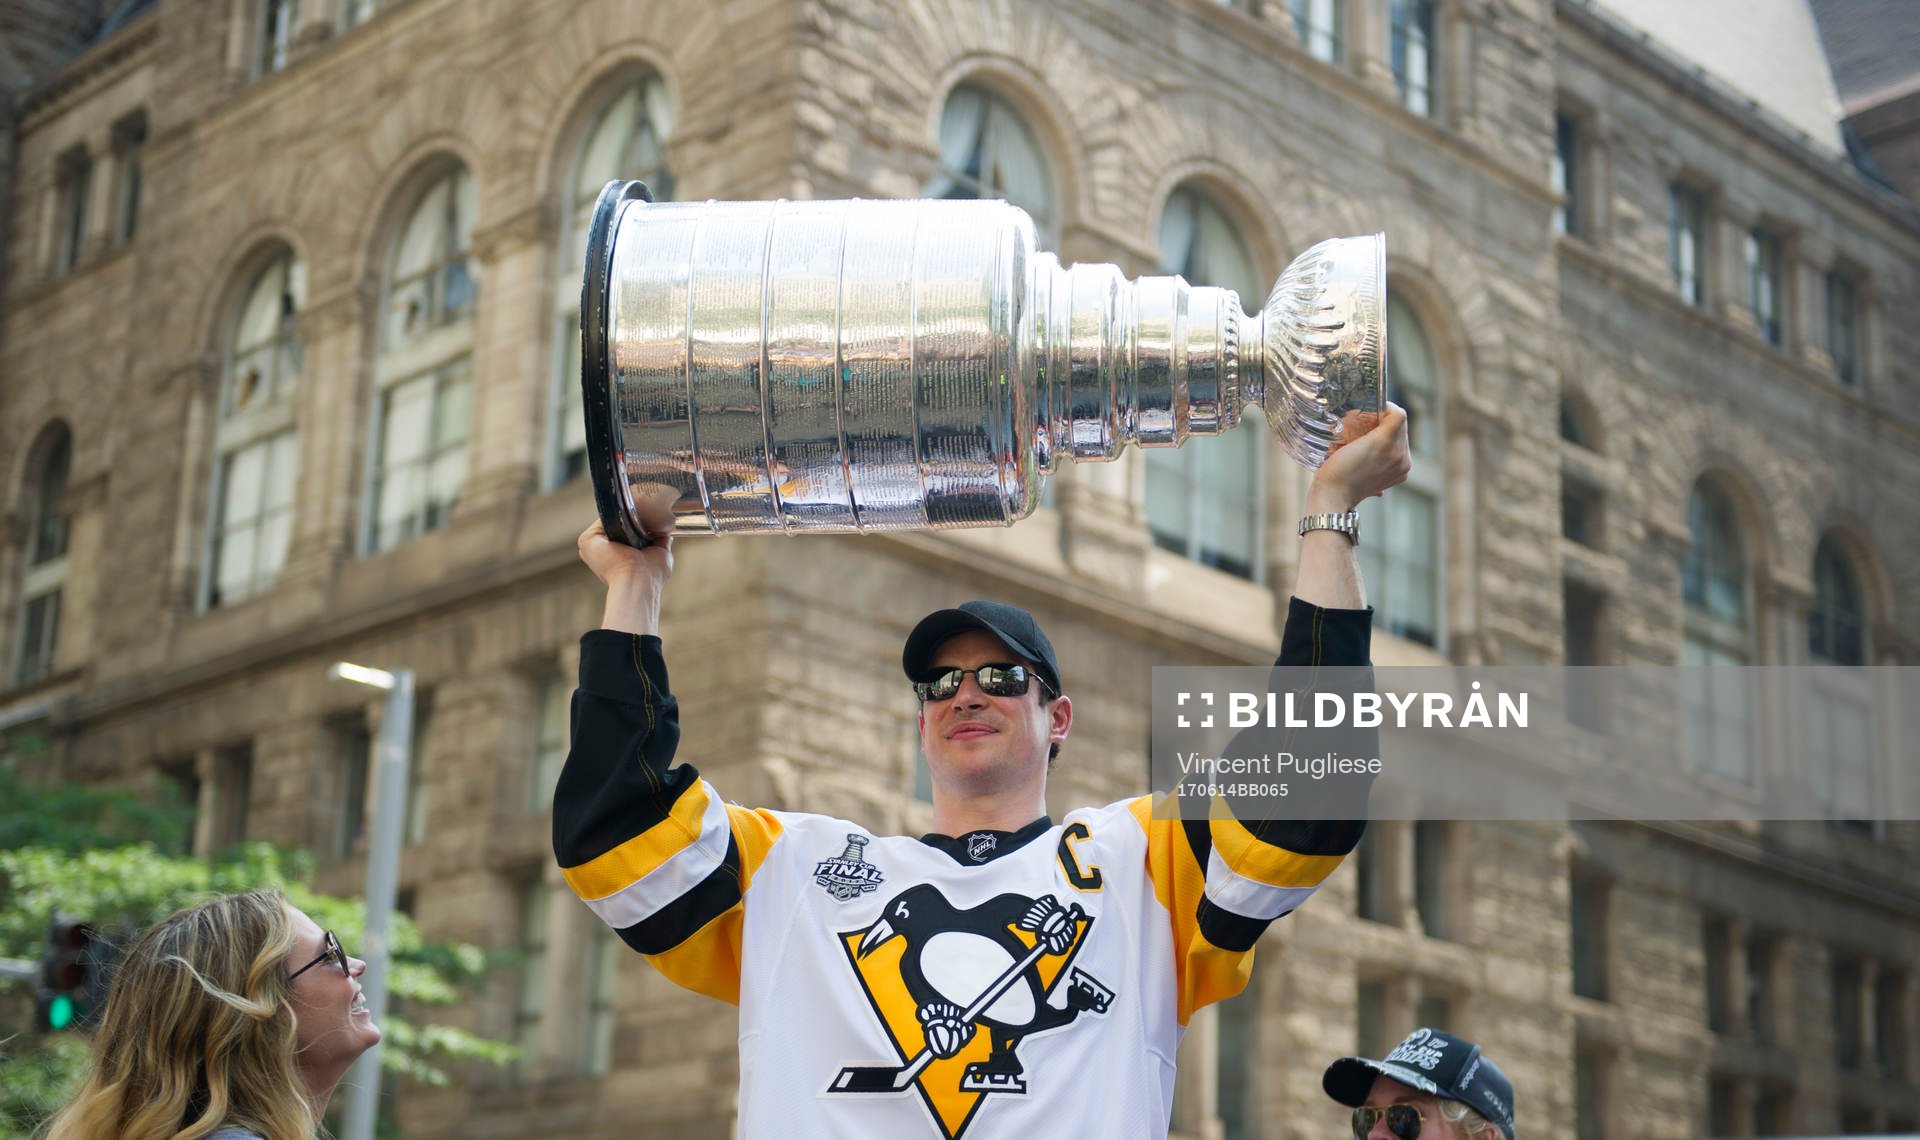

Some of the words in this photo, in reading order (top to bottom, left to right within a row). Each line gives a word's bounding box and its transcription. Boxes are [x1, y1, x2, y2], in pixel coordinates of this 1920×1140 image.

[973, 841, 992, 856] NHL
[1055, 820, 1105, 893] C
[828, 858, 859, 867] STANLEY
[815, 863, 883, 883] FINAL
